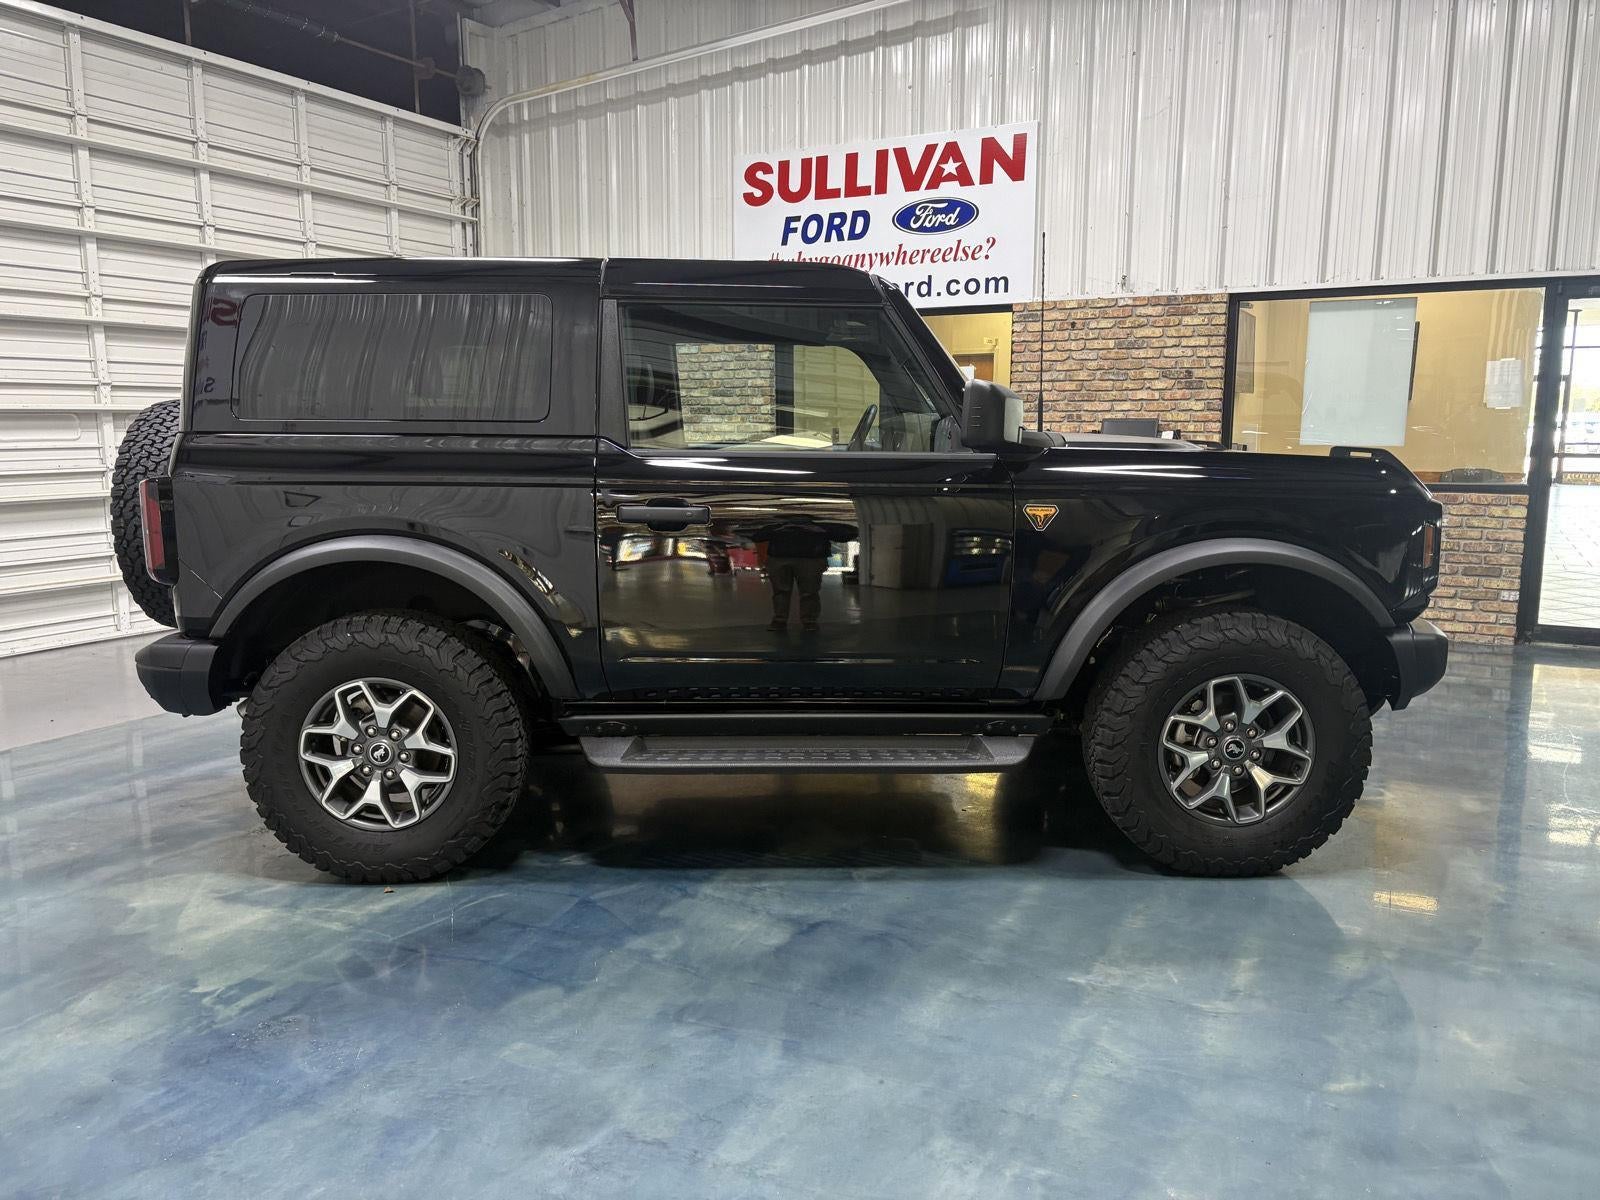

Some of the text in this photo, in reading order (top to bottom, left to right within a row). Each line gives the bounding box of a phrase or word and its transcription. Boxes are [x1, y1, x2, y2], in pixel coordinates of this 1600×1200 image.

[742, 132, 1028, 207] SULLIVAN
[780, 209, 871, 246] FORD
[909, 202, 960, 227] Ford
[769, 236, 997, 273] hoanywhereelse?
[892, 274, 1009, 298] rd.com
